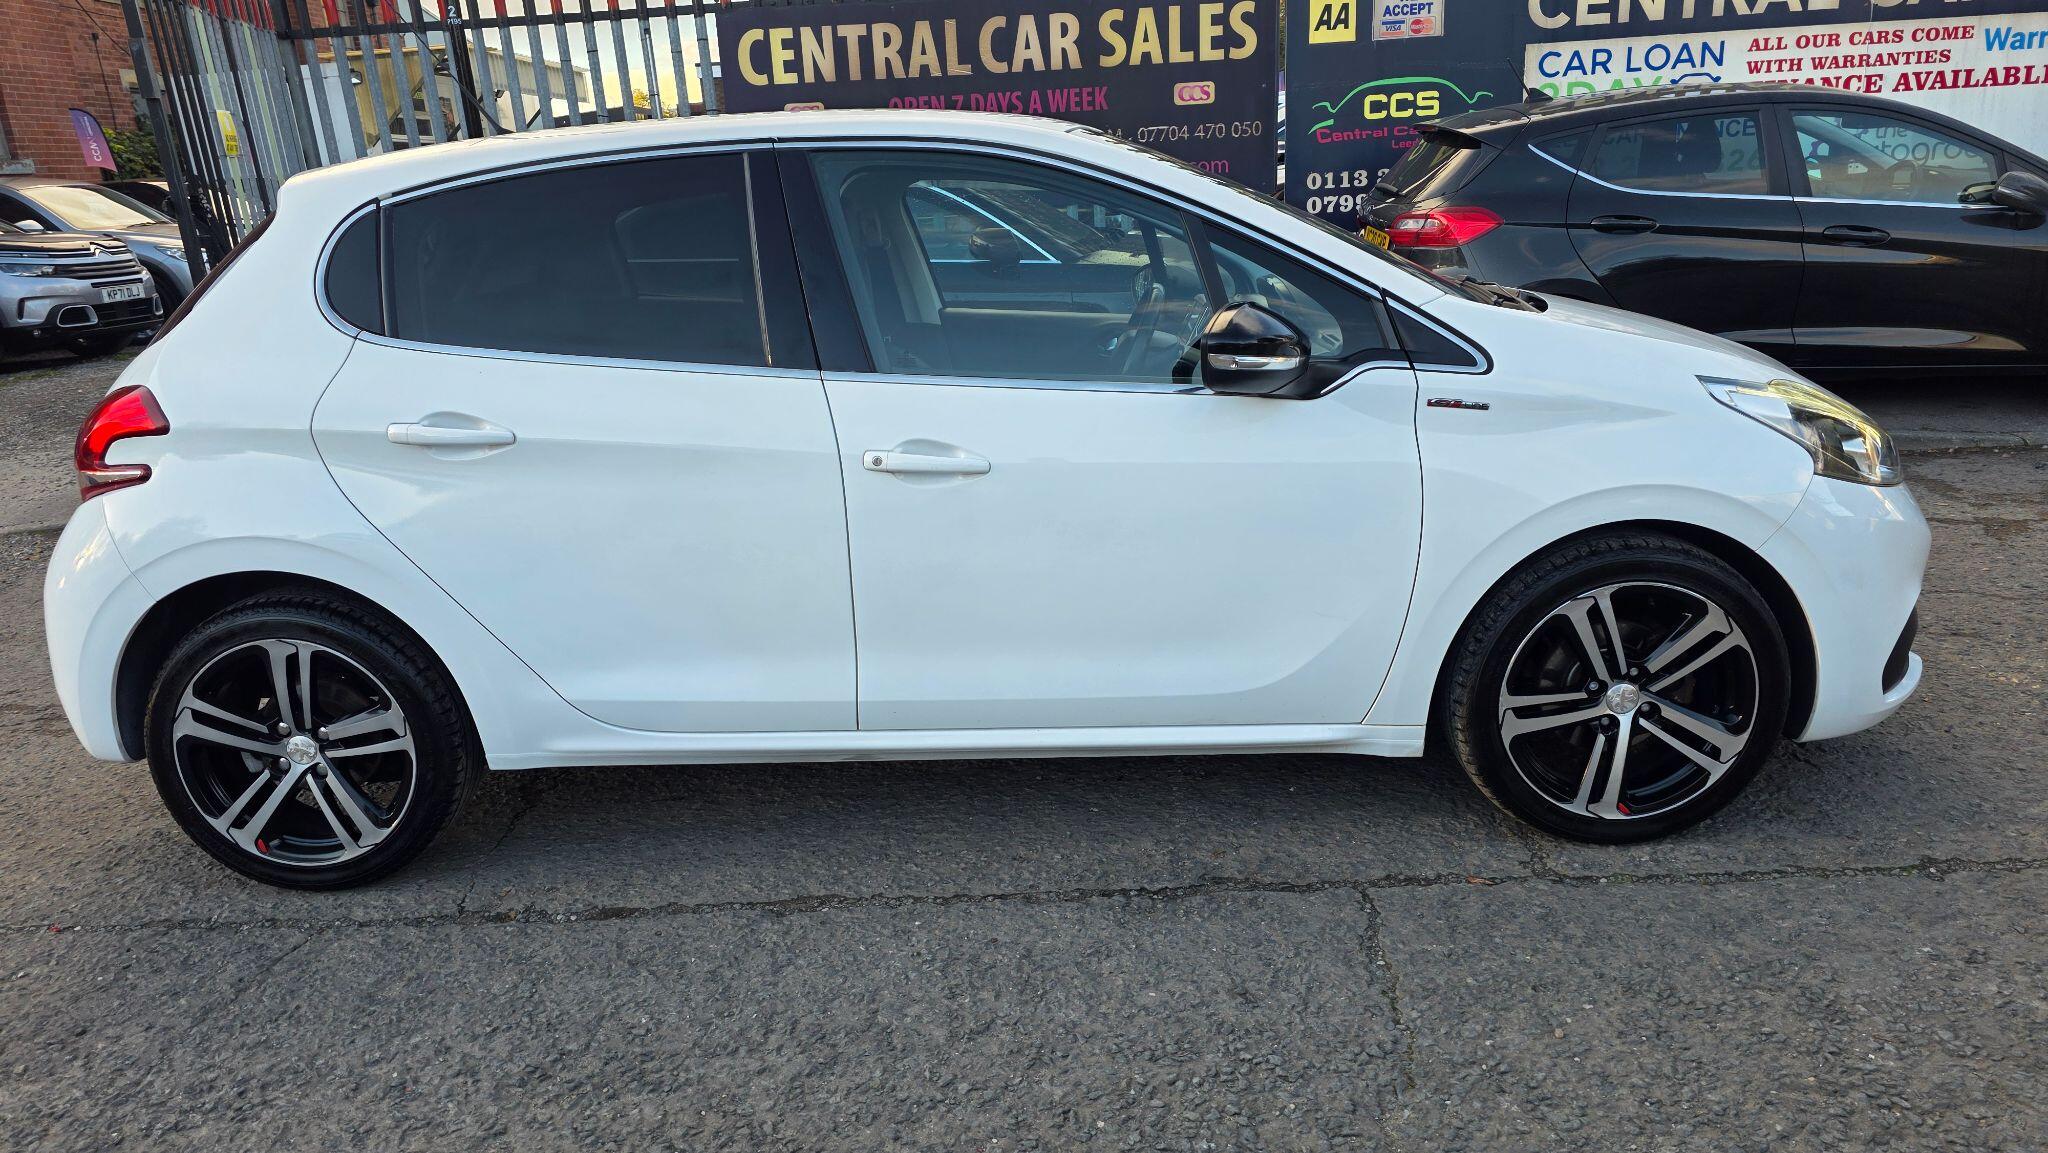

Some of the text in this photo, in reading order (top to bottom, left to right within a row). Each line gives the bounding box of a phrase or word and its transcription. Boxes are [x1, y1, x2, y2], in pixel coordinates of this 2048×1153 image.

[447, 5, 457, 17] 2
[1313, 2, 1350, 32] AA
[1382, 2, 1434, 18] ACCEPT
[1385, 24, 1402, 32] VISA
[1748, 25, 1975, 52] ALL OUR CARS COME
[737, 0, 1258, 86] CENTRAL CAR SALES
[1538, 40, 1726, 78] CAR LOAN
[1746, 48, 1952, 75] WITH WARRANTIES
[1028, 89, 1043, 114] A
[1046, 86, 1109, 113] WEEK
[1177, 84, 1212, 102] CCS
[1363, 91, 1440, 120] CCS
[1137, 124, 1190, 143] 07704
[1194, 121, 1226, 140] 470
[1231, 120, 1262, 138] 050
[1316, 127, 1389, 144] Central
[1306, 169, 1369, 190] 0113
[107, 286, 140, 300] KP71 DLJ
